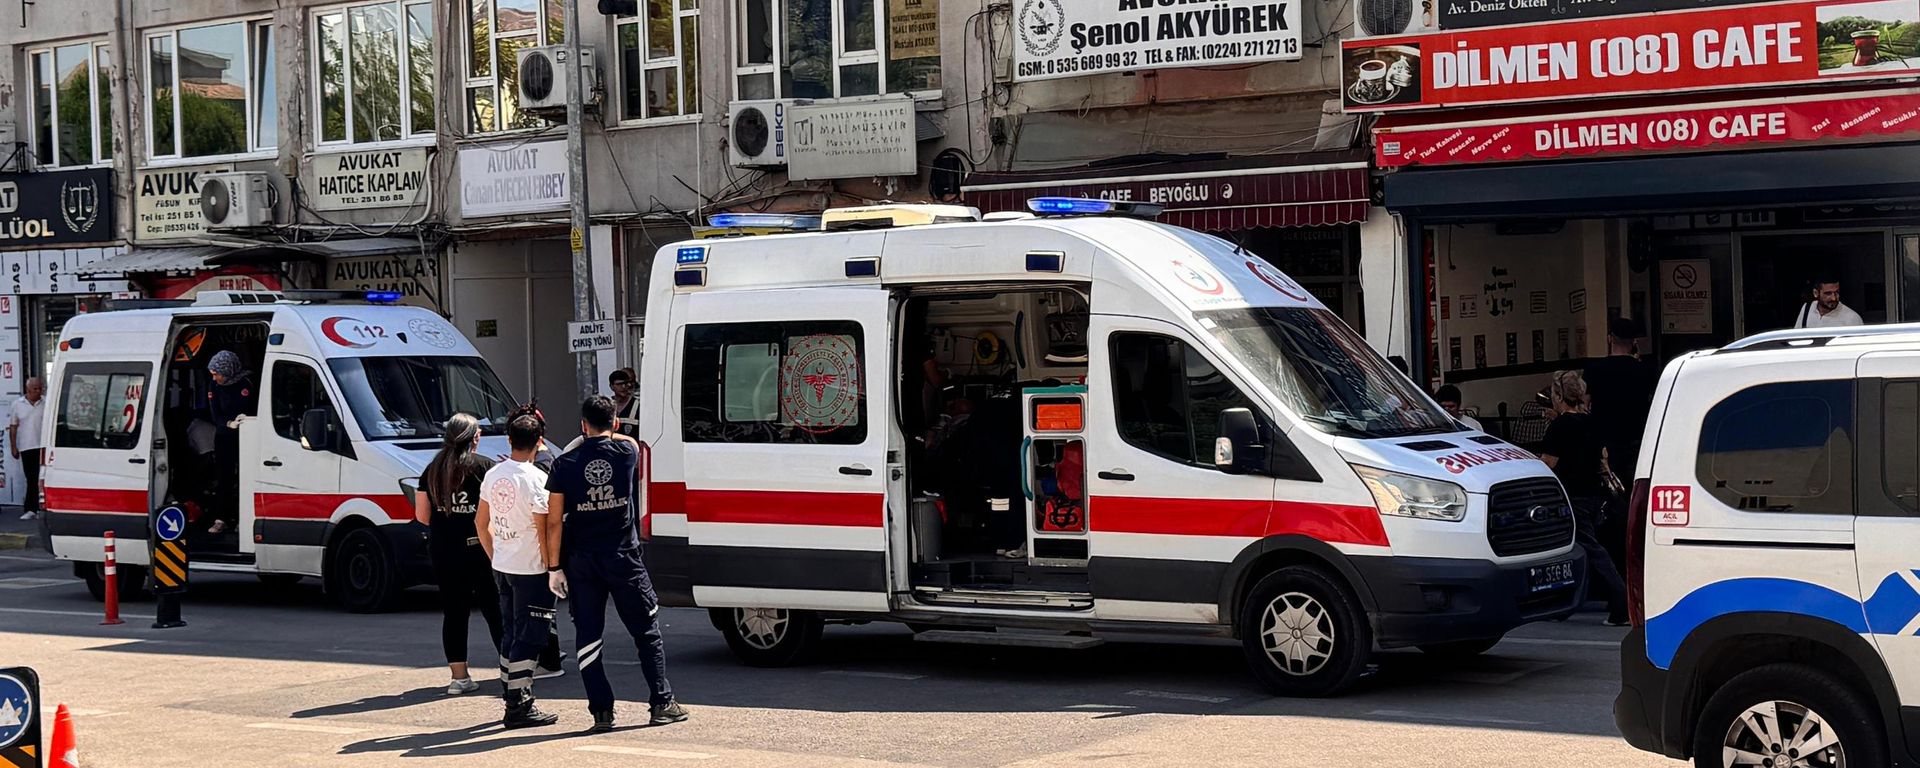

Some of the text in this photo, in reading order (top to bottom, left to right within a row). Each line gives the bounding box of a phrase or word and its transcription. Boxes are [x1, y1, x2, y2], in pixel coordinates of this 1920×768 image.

[1448, 3, 1466, 14] Av.
[1470, 0, 1505, 12] Deniz
[1070, 3, 1288, 54] Şenol AKYÜREK
[1018, 38, 1297, 76] GSM: 0 535 689 99 32 TEL & FAX: (0224) 271 27 13
[1432, 22, 1802, 89] DİLMEN (08) CAFE
[1812, 118, 1830, 132] Tost
[1882, 110, 1918, 128] Sucuklu
[774, 103, 784, 157] BEKO
[1436, 129, 1462, 150] Kahvesi
[1535, 112, 1786, 150] DİLMEN (08) CAFE
[1471, 127, 1510, 155] Meyve Suyu
[1502, 144, 1512, 154] Su
[338, 152, 402, 171] AVUKAT
[488, 148, 538, 173] AVUKAT
[1404, 147, 1416, 160] Çay
[368, 171, 420, 192] KAPLAN
[533, 172, 565, 199] ERBEY
[1100, 182, 1208, 203] CAFE BEYOĞLU
[334, 258, 437, 280] AVUKATLAR
[353, 325, 389, 338] 112
[580, 323, 604, 334] ADLİYE
[572, 334, 612, 350] ÇIKIŞ YÖNÜ
[587, 485, 615, 501] 112
[1657, 490, 1684, 509] 112
[577, 502, 596, 511] ACİL
